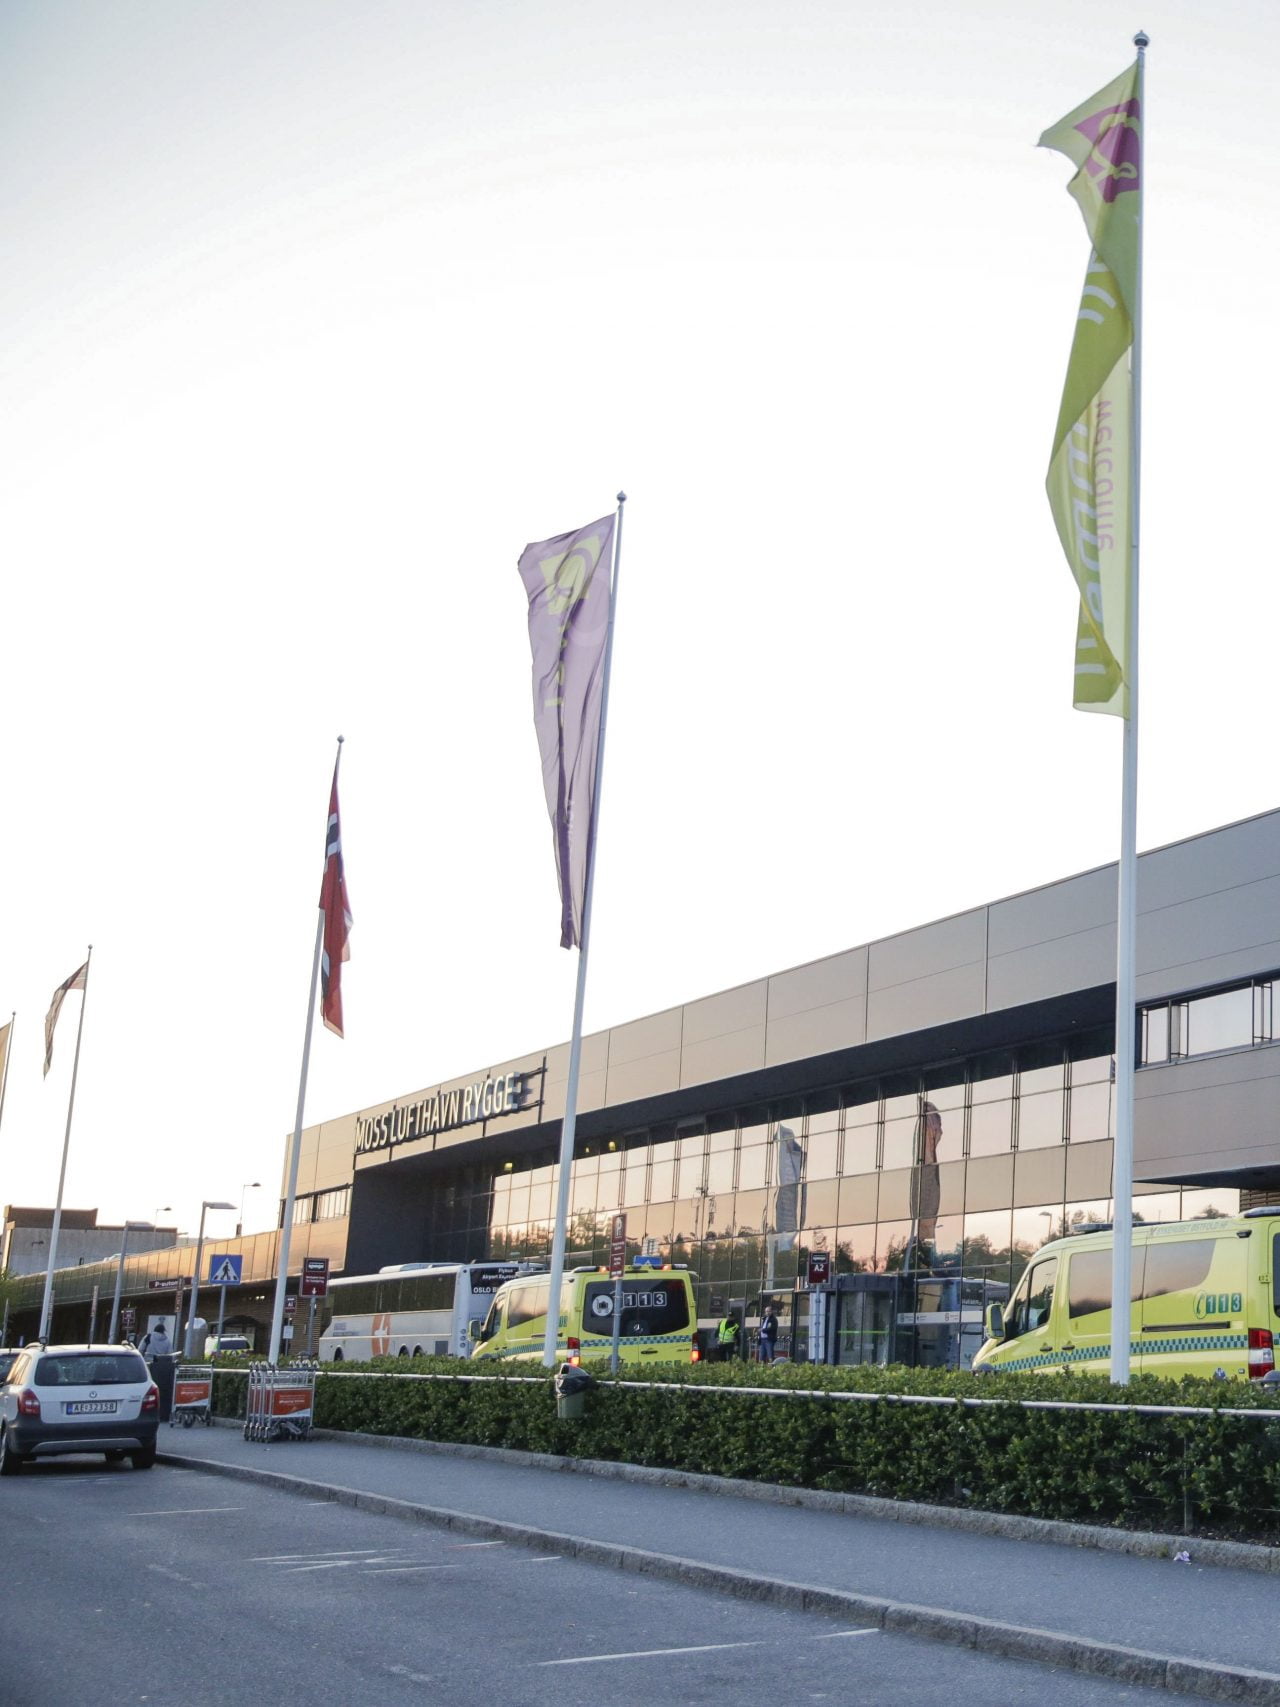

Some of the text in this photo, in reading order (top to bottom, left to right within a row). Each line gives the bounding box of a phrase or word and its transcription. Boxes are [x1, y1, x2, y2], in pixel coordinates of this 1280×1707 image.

[355, 1072, 521, 1151] MOSS LUFTHAVN RYGGE
[625, 1293, 666, 1306] 113
[1207, 1293, 1241, 1313] 113
